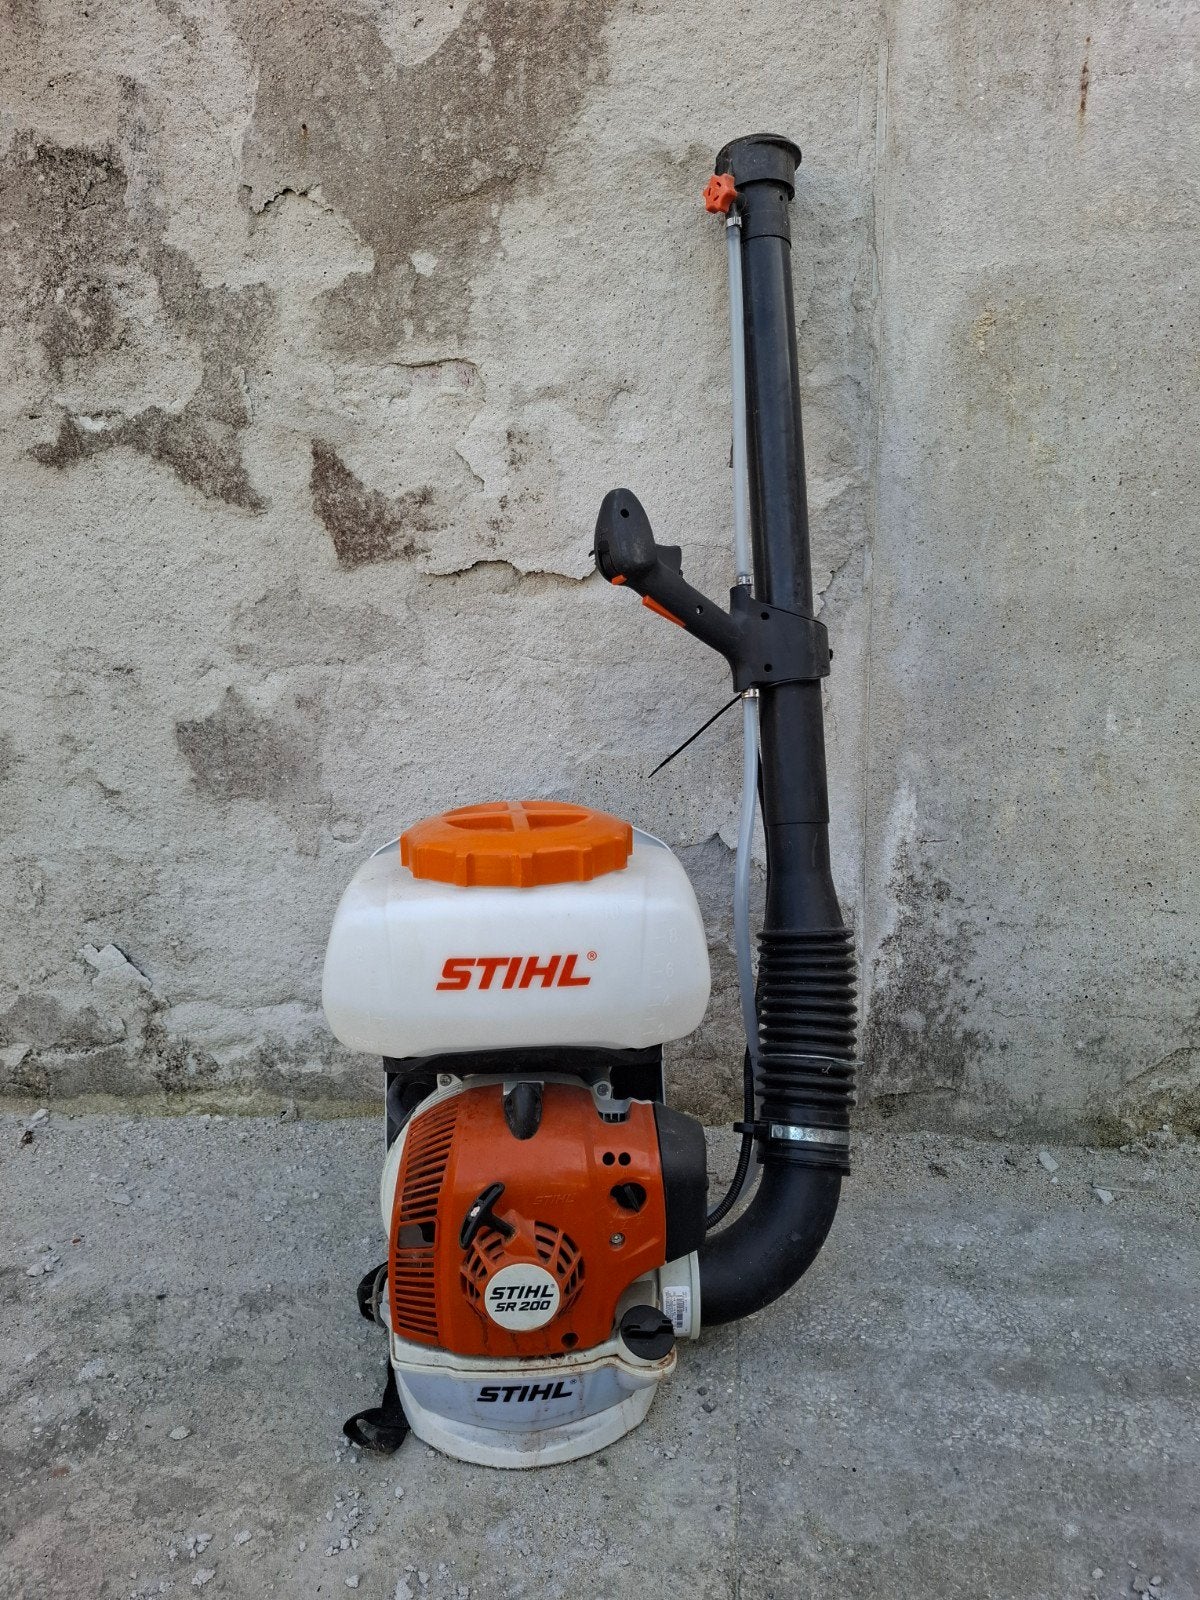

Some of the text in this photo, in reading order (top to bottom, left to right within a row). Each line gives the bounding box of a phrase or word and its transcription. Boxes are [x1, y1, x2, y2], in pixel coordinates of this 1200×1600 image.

[490, 1285, 554, 1300] STIHL
[495, 1300, 551, 1312] SR 200
